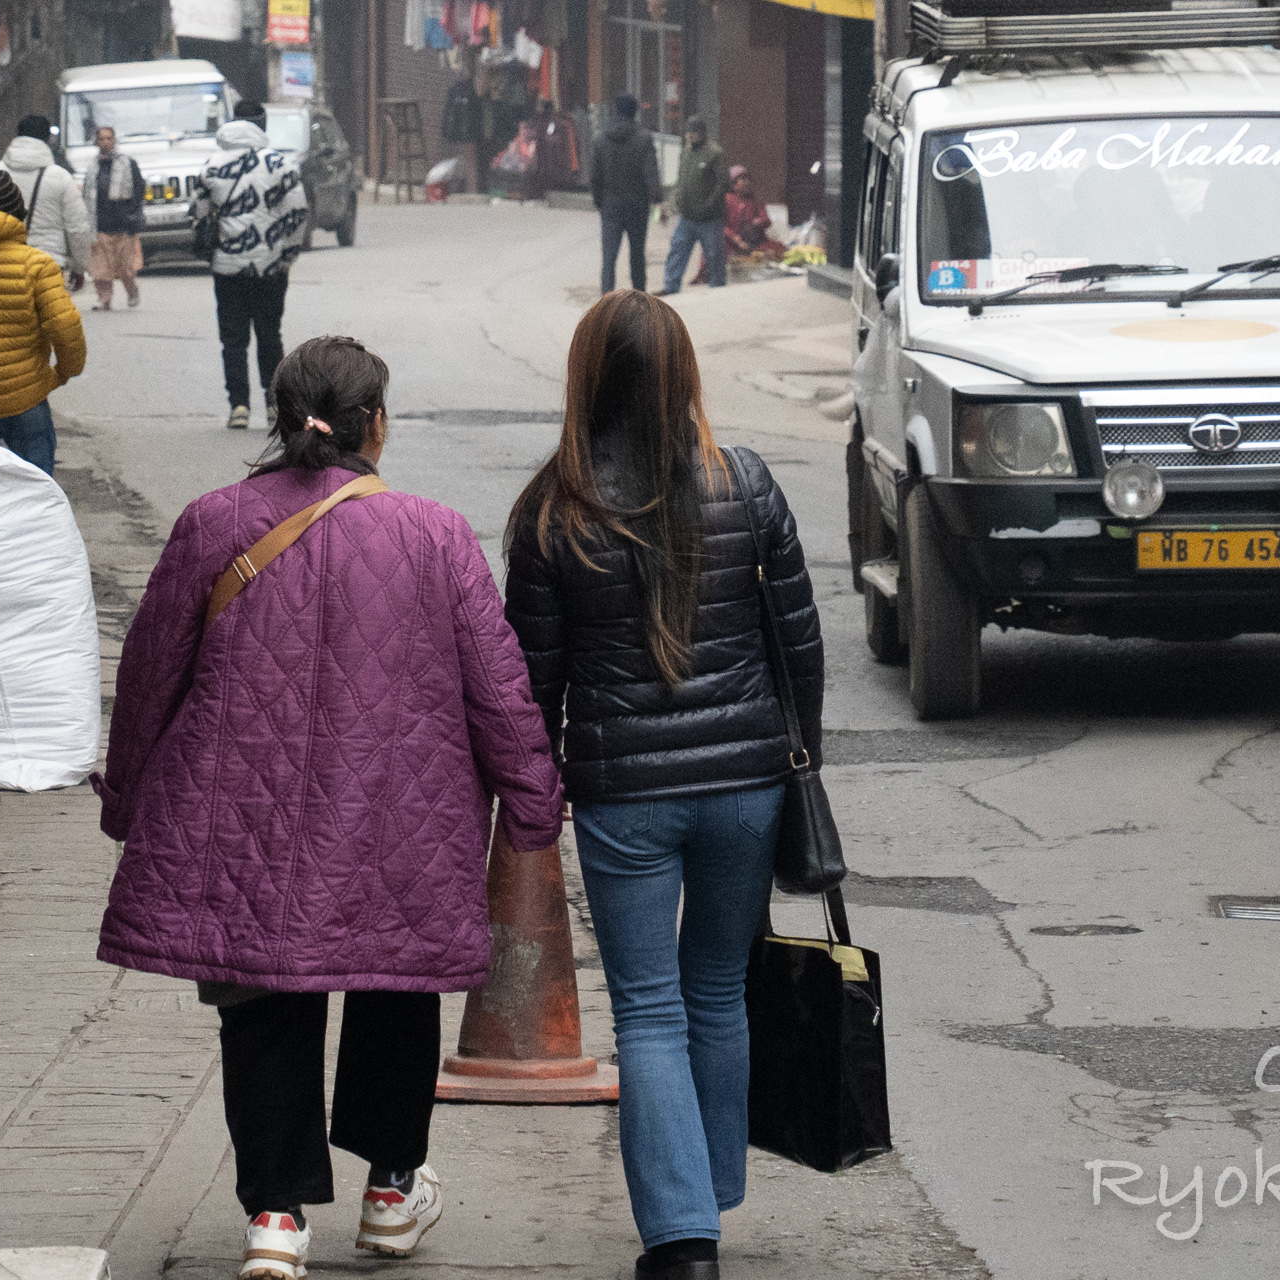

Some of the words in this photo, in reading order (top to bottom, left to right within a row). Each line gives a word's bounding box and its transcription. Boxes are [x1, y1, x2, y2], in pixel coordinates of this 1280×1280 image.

[931, 126, 1089, 182] Baba
[937, 269, 955, 286] B
[1161, 538, 1189, 563] WB
[1202, 538, 1230, 563] 76
